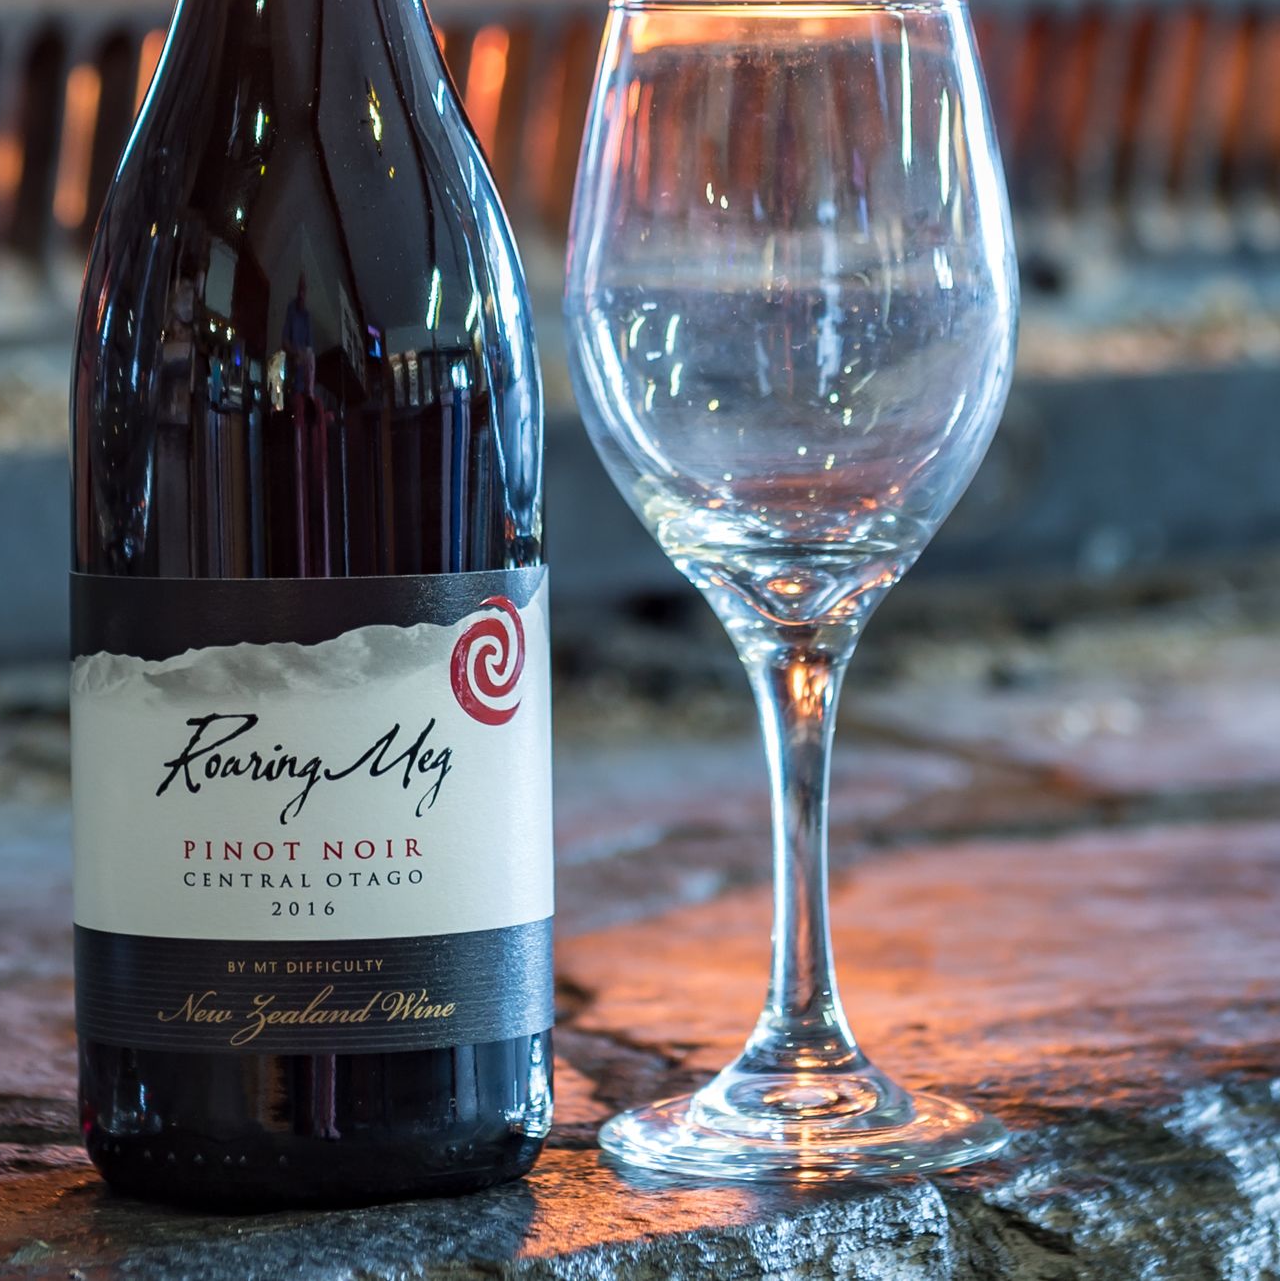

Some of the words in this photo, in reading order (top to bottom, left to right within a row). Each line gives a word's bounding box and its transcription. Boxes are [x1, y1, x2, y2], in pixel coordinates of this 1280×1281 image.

[155, 712, 322, 825] Roaring
[323, 718, 453, 818] Meg
[183, 840, 302, 862] PINOT
[322, 837, 423, 860] NOIR
[183, 871, 311, 889] CENTRAL
[325, 869, 424, 888] OTAGO
[271, 901, 336, 917] 2016
[227, 960, 247, 974] BY
[254, 960, 279, 974] MT
[286, 958, 385, 974] DIFFICULTY
[157, 990, 233, 1023] New
[229, 984, 379, 1047] Zealand
[380, 990, 457, 1021] Wine
